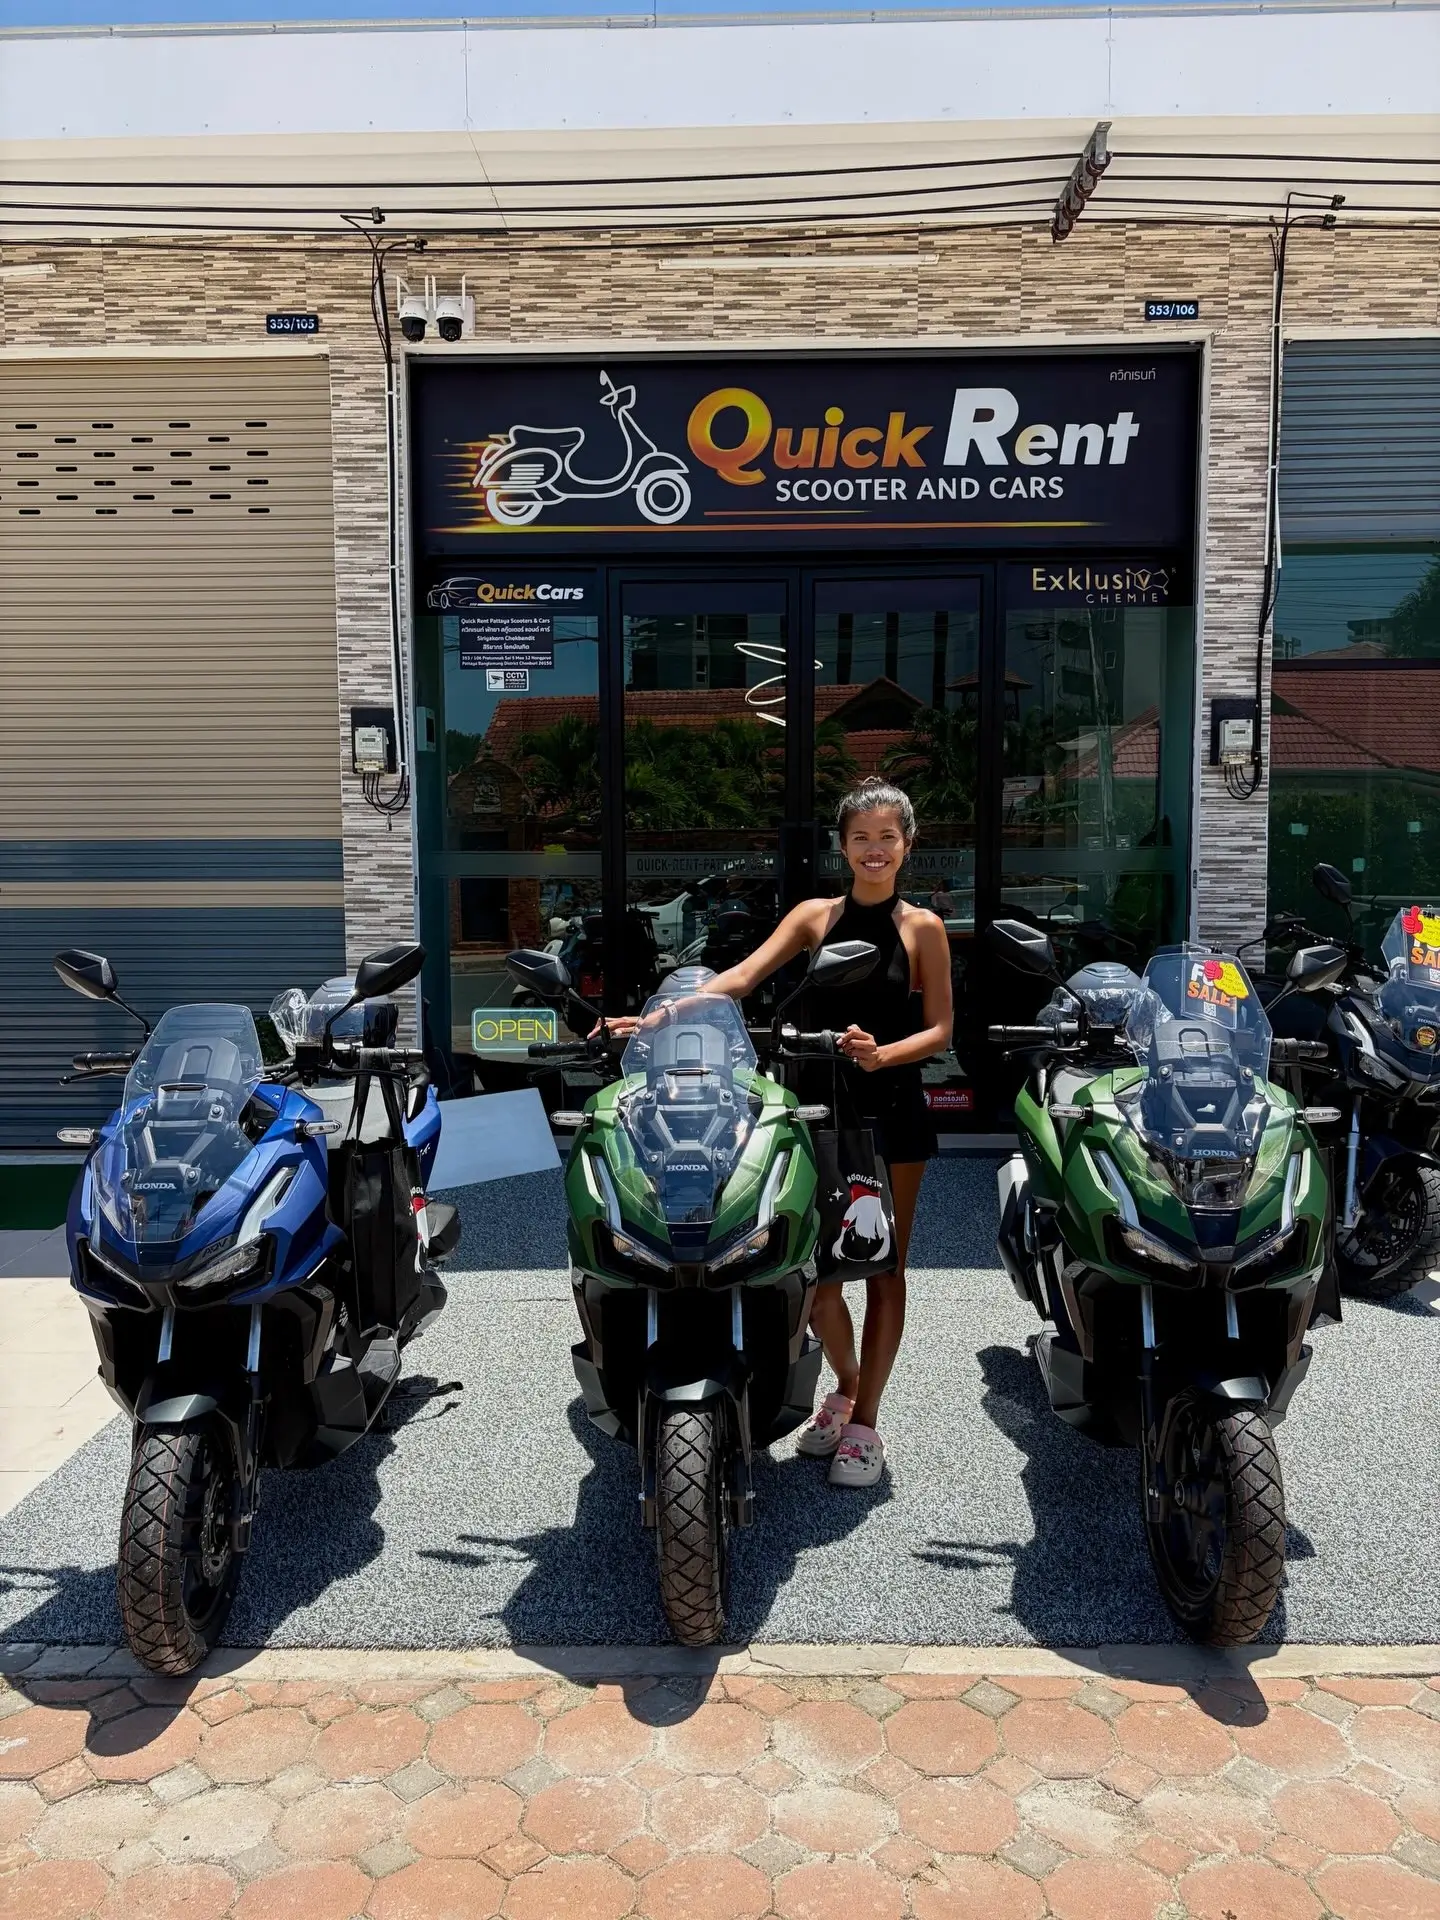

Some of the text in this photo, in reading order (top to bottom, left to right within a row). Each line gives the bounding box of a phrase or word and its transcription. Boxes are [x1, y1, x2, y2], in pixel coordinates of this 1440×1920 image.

[1149, 304, 1195, 317] 353/106
[269, 318, 315, 331] 353/105
[1109, 368, 1156, 381] ควิกเรนท์
[687, 387, 1140, 486] Quick Rent
[776, 476, 1064, 502] SCOOTER AND CARS
[477, 583, 584, 602] QuickCars
[1086, 592, 1159, 604] CHEMIE
[1187, 981, 1231, 1006] SALE
[477, 1019, 552, 1041] OPEN
[1192, 1149, 1237, 1158] HONDA
[666, 1164, 709, 1172] HONDA
[134, 1182, 177, 1190] HONDA
[203, 1238, 228, 1258] ADV
